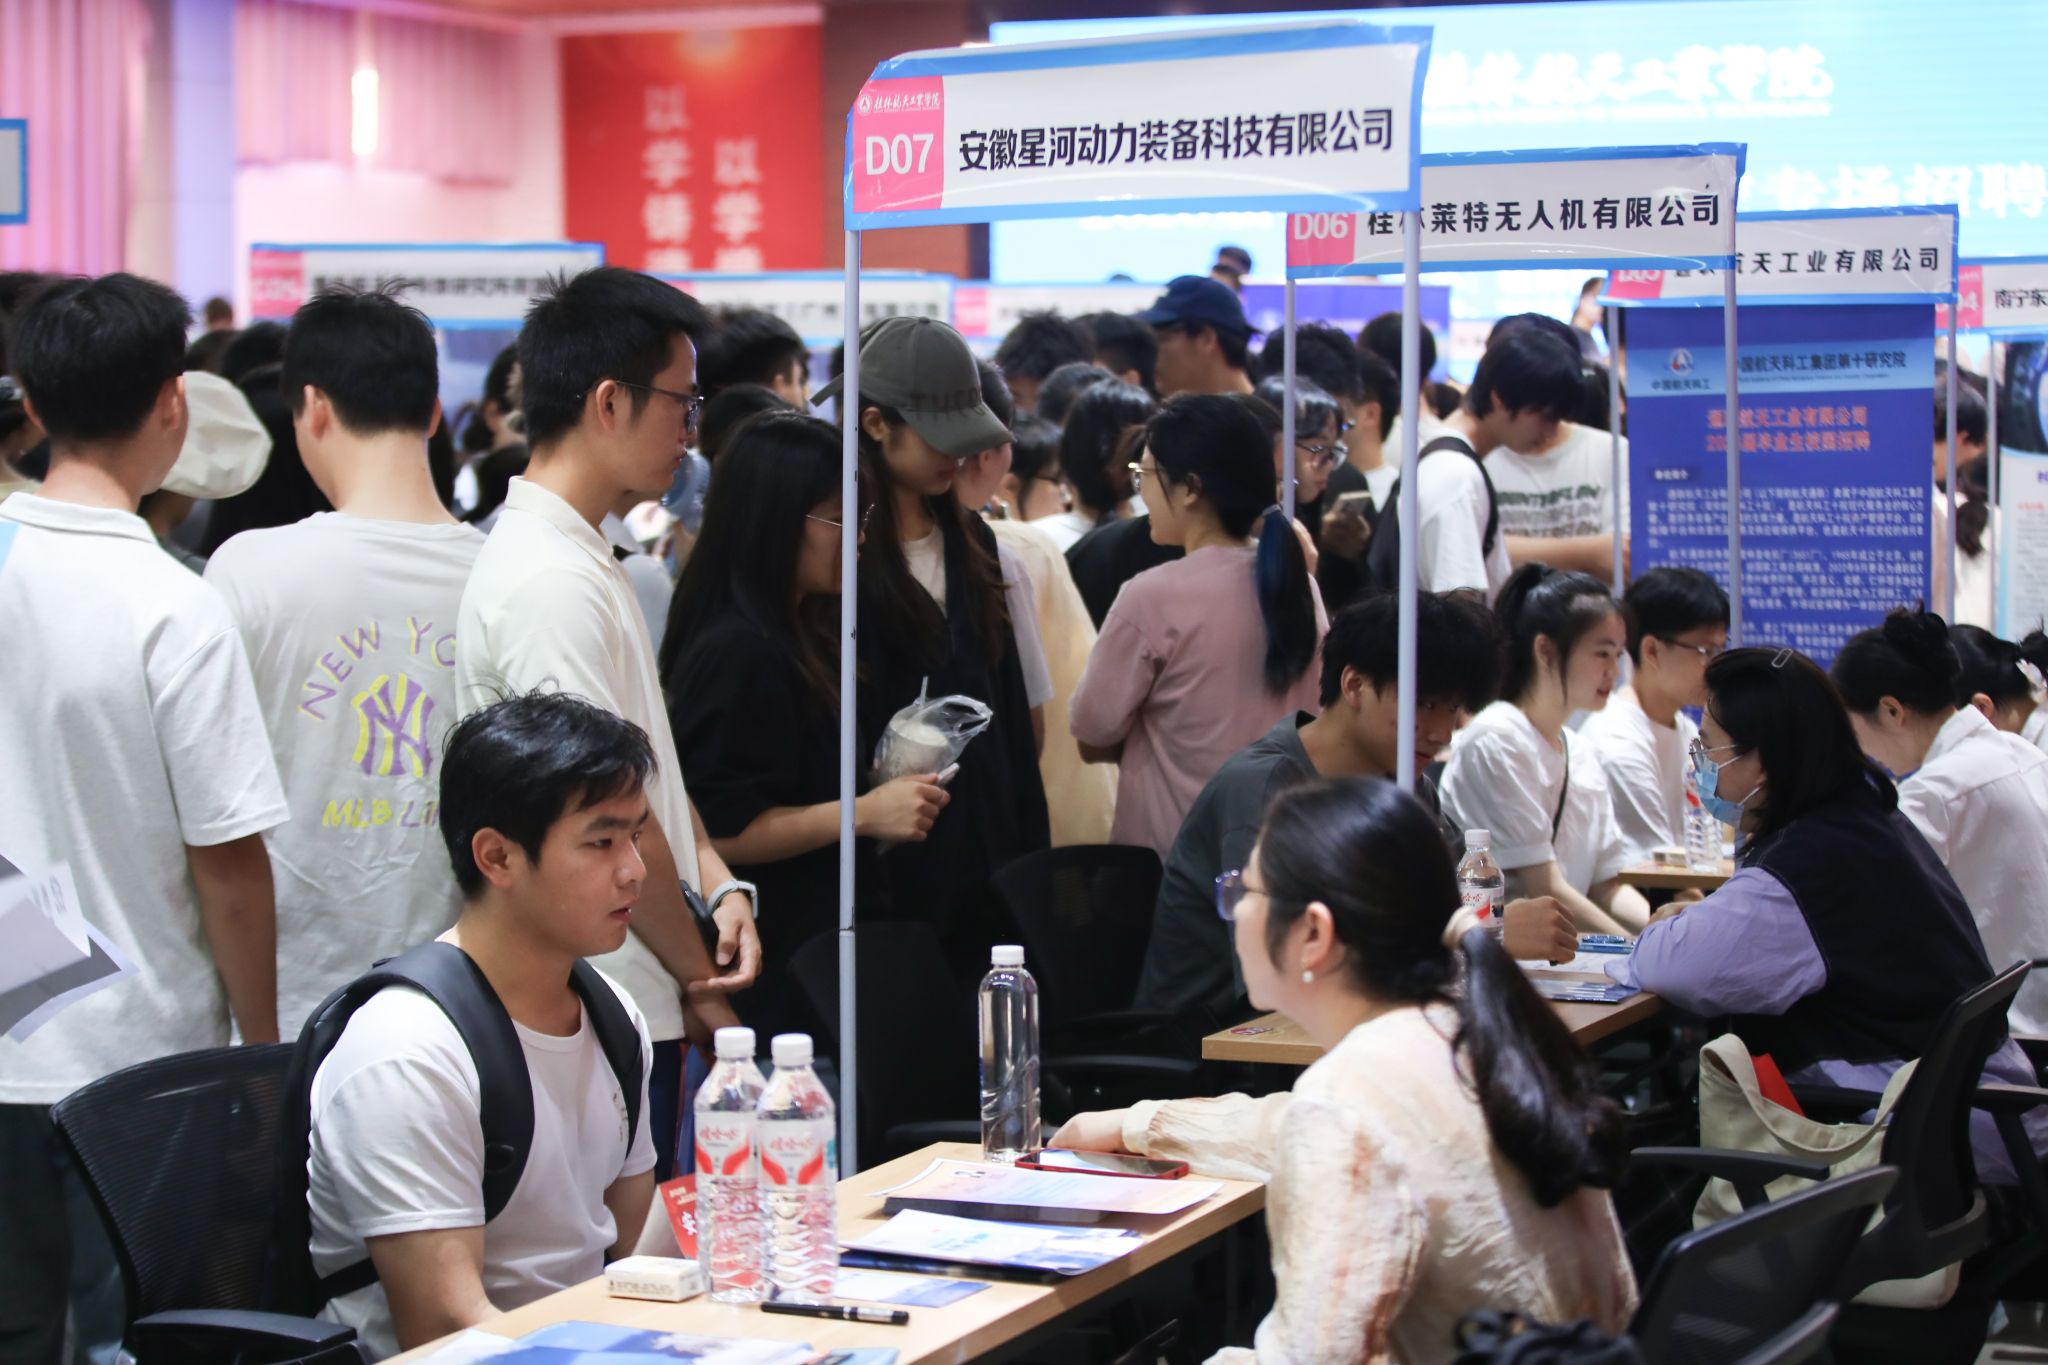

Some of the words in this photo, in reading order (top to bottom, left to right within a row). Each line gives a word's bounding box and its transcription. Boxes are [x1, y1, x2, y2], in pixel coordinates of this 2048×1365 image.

[866, 132, 934, 175] D07
[959, 107, 1393, 172] 安徽星河动力装备科技有限公司
[1294, 212, 1348, 240] D06
[1737, 351, 1907, 373] 国航天科工集团第十研究院
[298, 621, 381, 721] NEW
[322, 799, 393, 828] MLB
